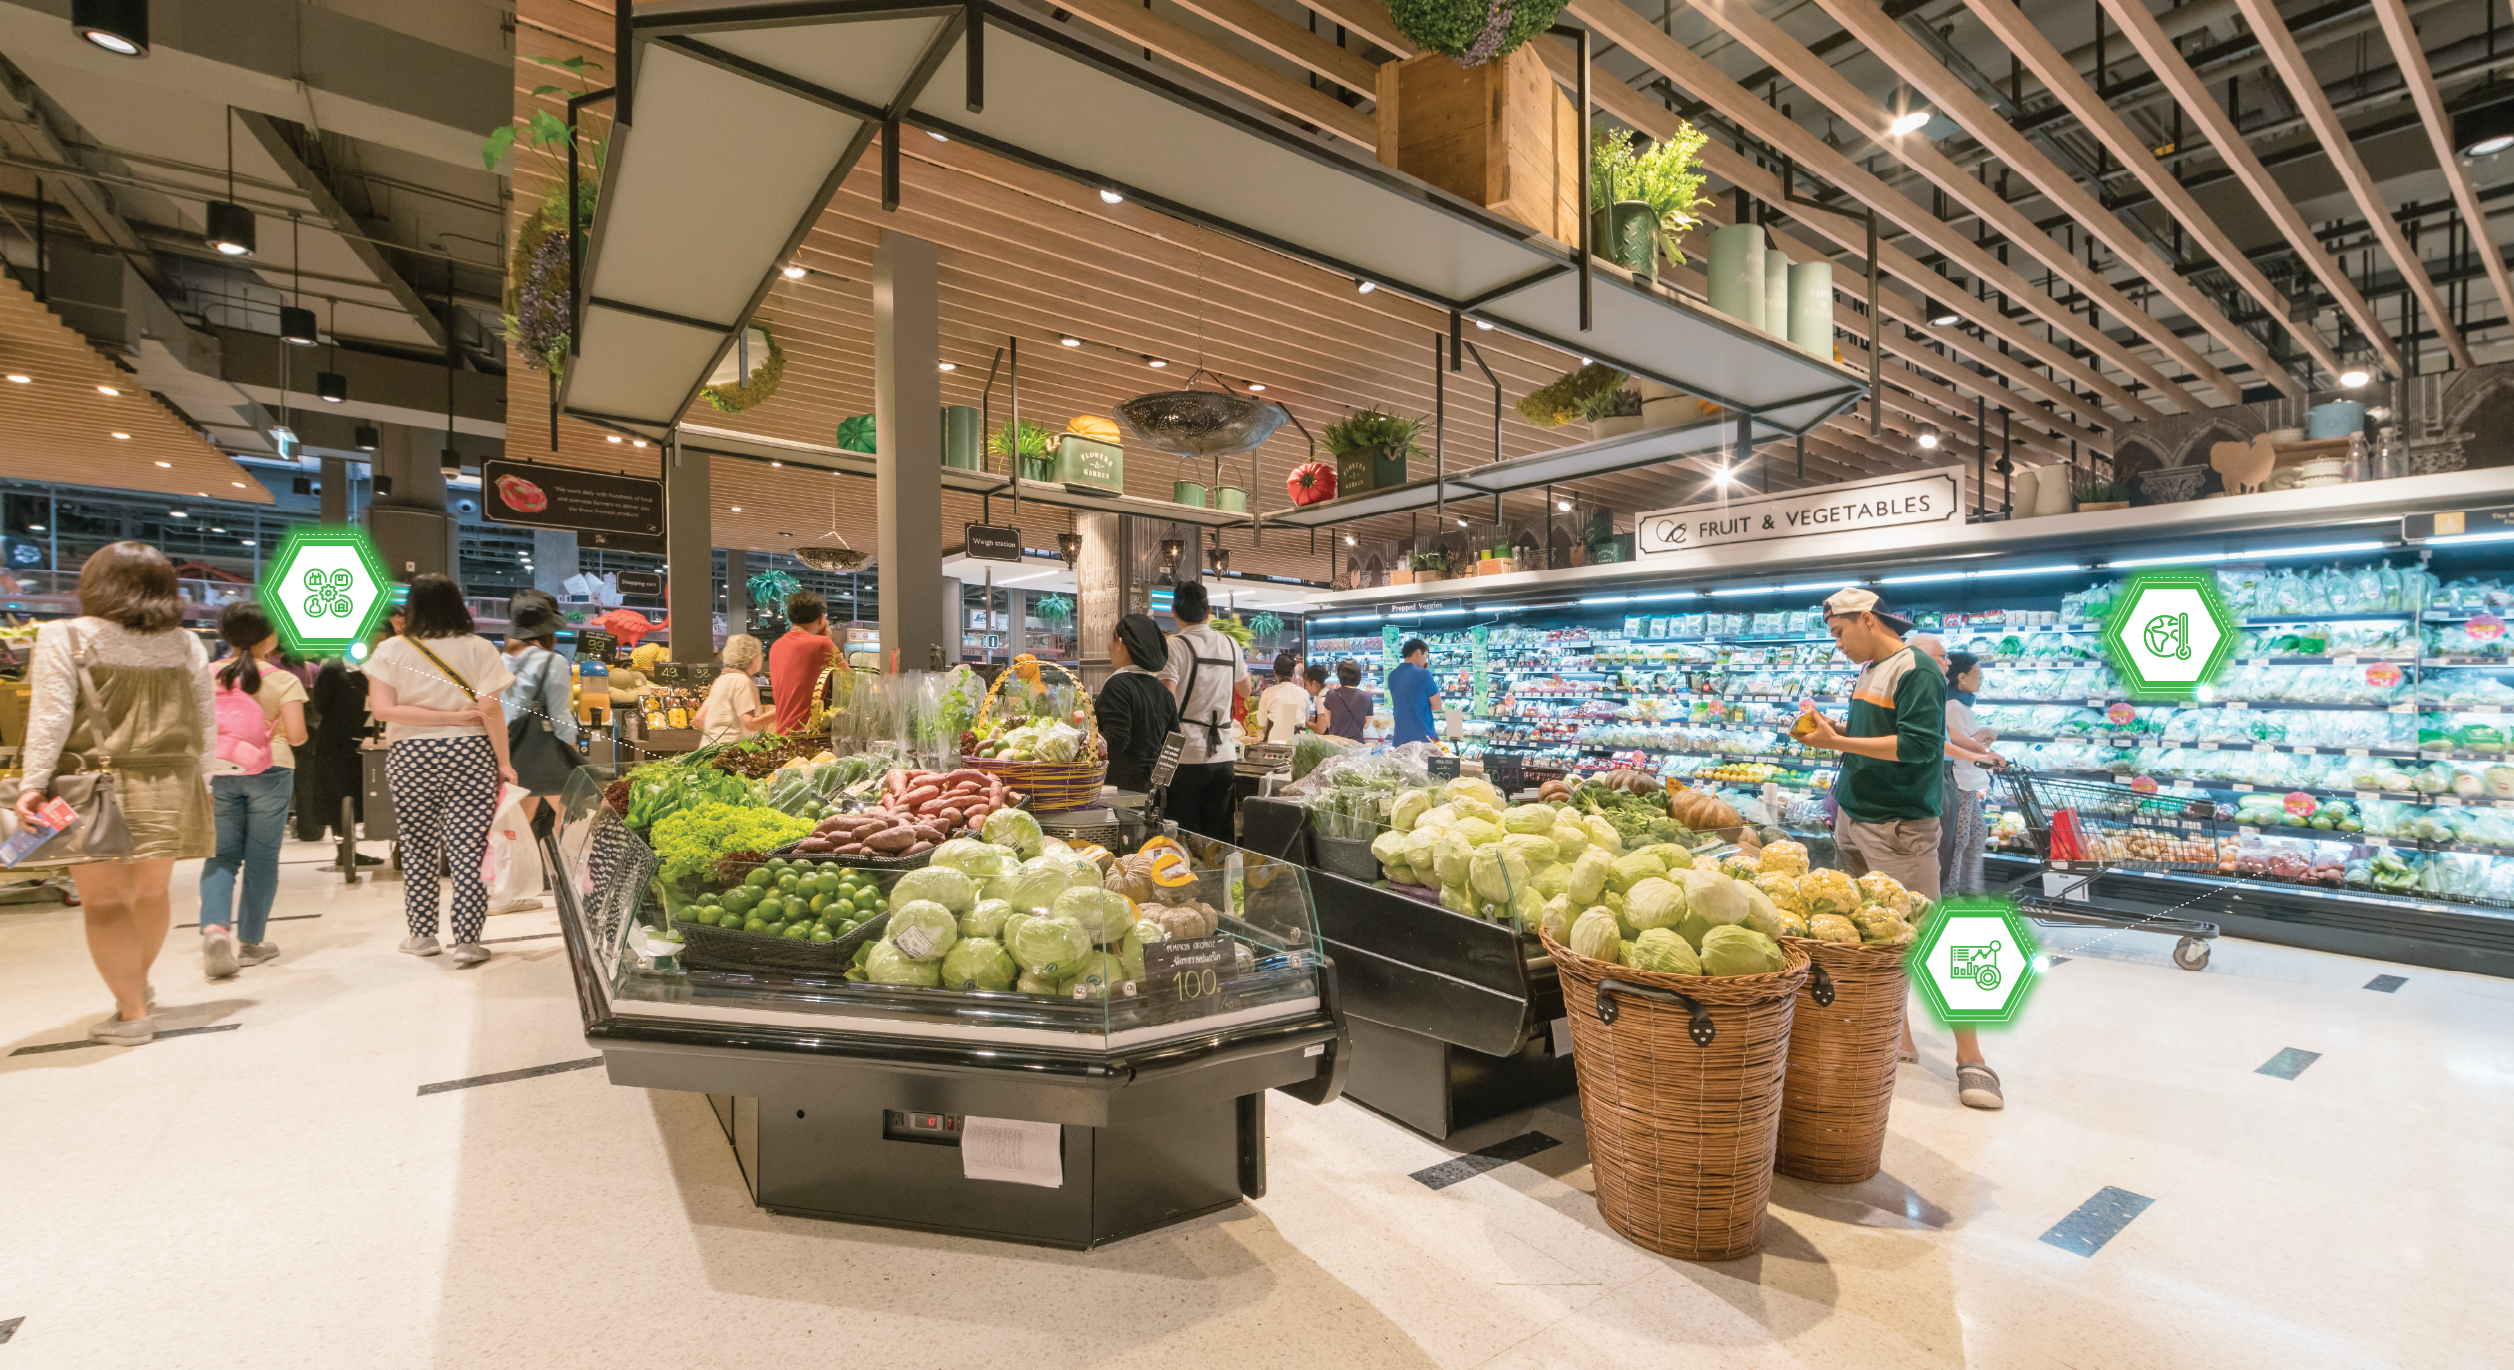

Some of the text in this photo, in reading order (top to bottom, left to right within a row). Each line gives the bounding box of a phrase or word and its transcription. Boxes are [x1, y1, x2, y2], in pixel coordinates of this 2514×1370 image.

[1080, 451, 1113, 467] FLOWERS
[1083, 468, 1110, 480] GARDEN
[1699, 515, 1752, 538] FRUIT
[1761, 513, 1776, 530] &
[1785, 494, 1932, 528] VEGETABLES
[972, 537, 1016, 548] Weigh station
[621, 579, 645, 587] Shopping
[1391, 601, 1443, 612] Prepped Veggies
[1166, 942, 1191, 953] PUMPKIN
